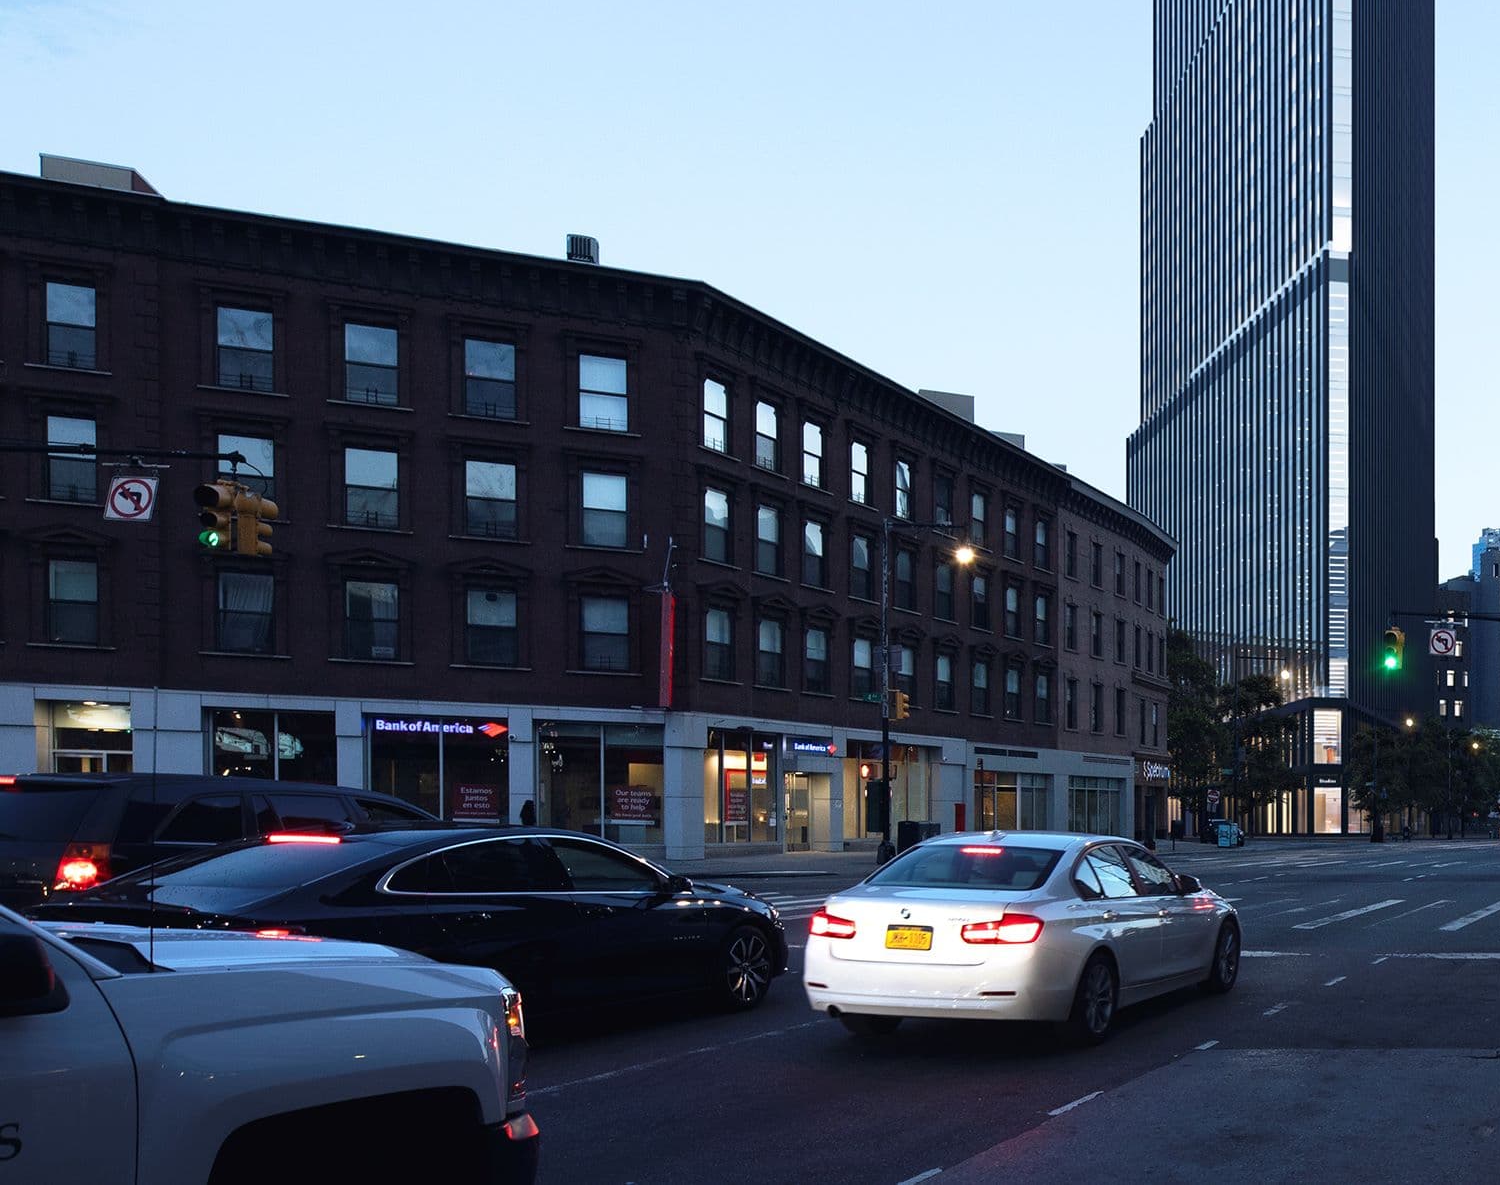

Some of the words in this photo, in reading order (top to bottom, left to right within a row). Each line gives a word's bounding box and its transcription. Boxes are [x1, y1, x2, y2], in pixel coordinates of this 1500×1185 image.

[375, 719, 408, 731] Bank
[408, 721, 423, 731] of
[423, 721, 474, 734] America
[795, 742, 804, 750] Bank
[810, 744, 826, 752] America
[630, 797, 650, 805] ready
[630, 804, 646, 812] help
